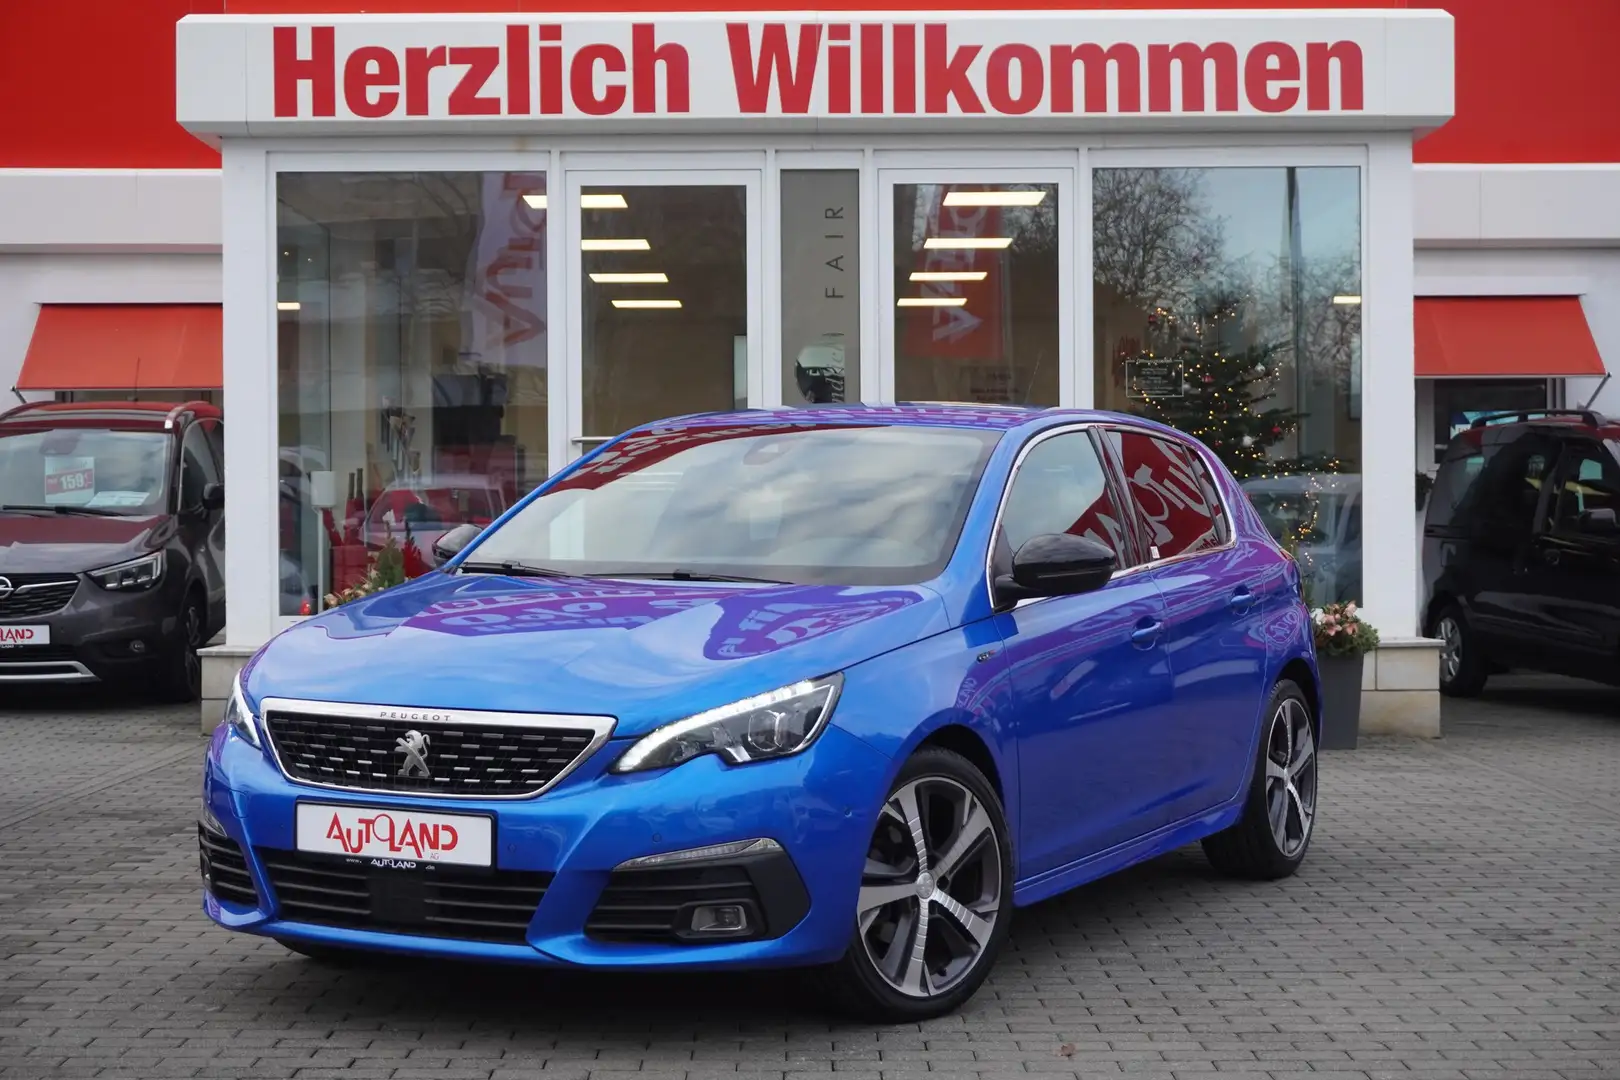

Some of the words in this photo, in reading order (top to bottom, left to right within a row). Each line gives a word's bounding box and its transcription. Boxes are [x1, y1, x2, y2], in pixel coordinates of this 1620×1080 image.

[273, 23, 690, 118] Herzlich
[726, 22, 1364, 114] Willkommen
[0, 628, 34, 643] LAND
[380, 711, 451, 721] PEUGEOT
